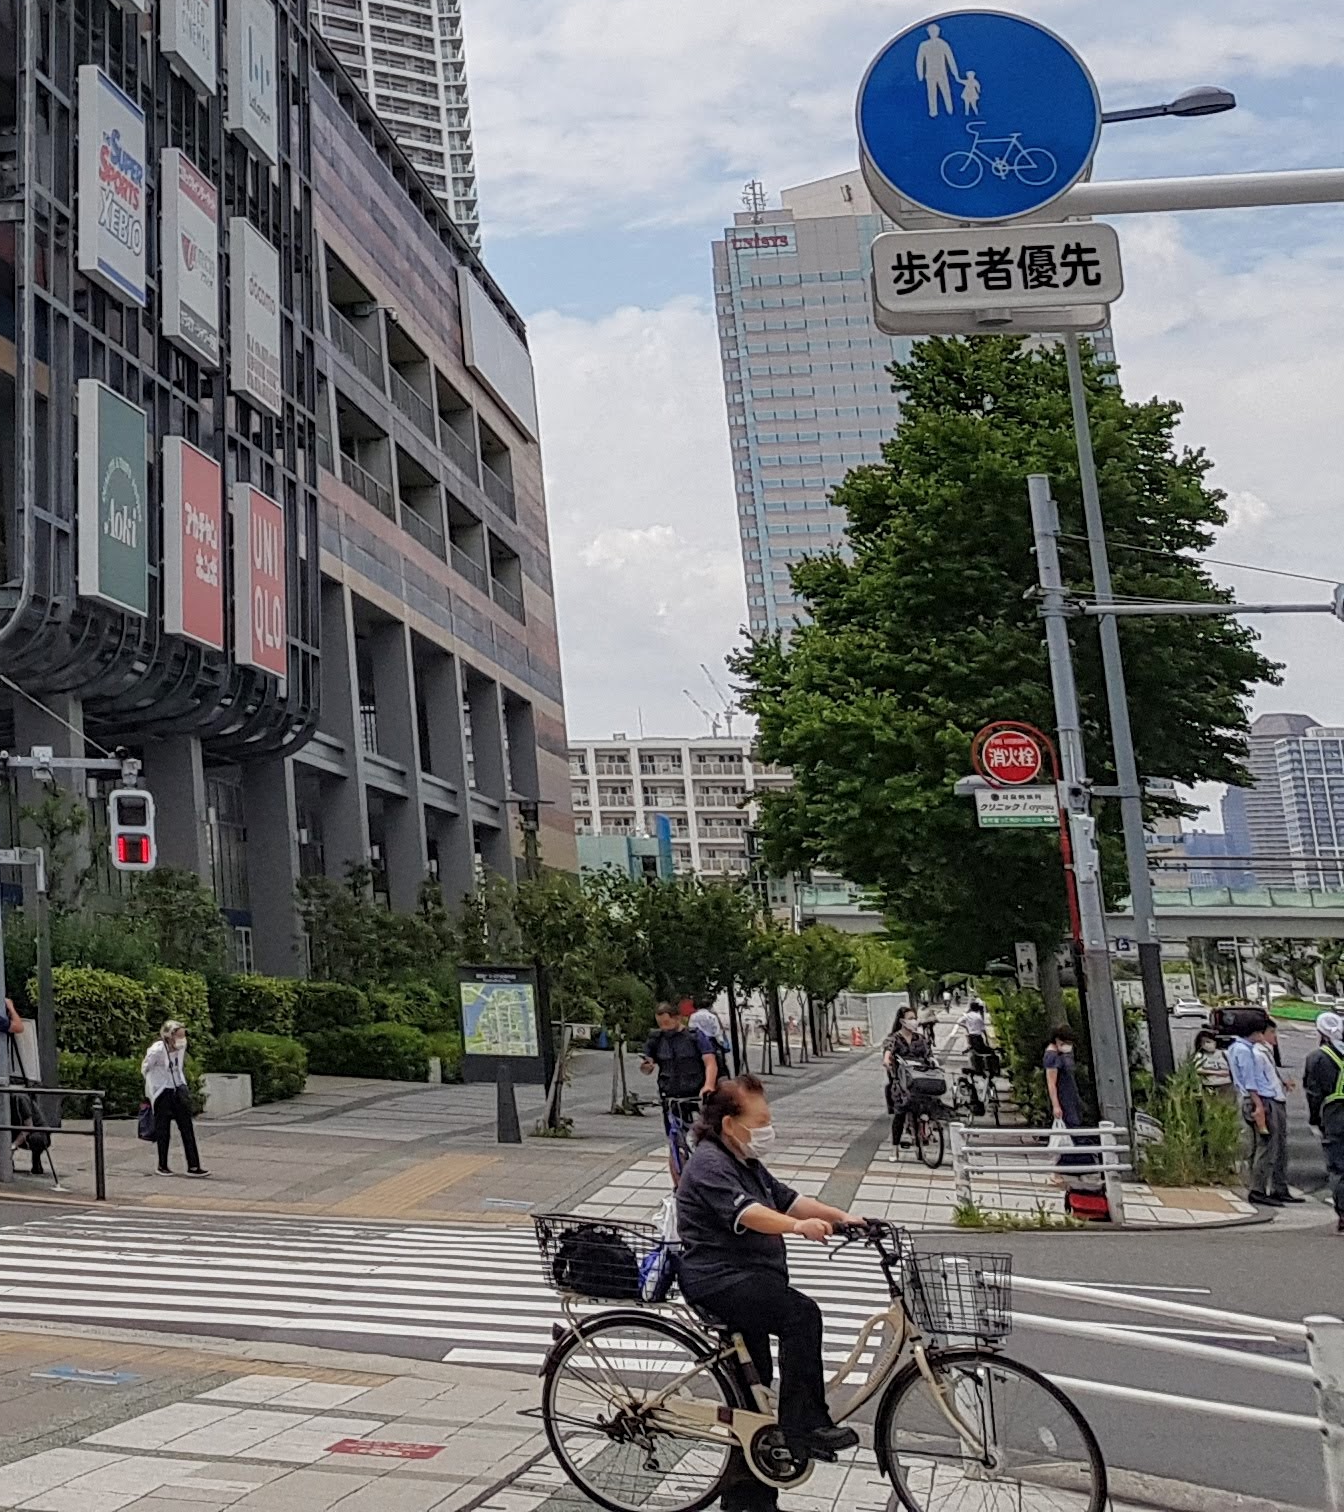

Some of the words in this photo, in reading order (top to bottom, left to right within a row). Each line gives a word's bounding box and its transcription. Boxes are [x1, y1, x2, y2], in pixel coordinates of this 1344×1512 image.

[98, 182, 143, 257] XEBIO
[891, 241, 1102, 296] 歩行者優先
[104, 498, 136, 548] Aoki
[252, 512, 279, 581] UNI
[254, 584, 282, 654] QLO
[988, 747, 1036, 767] 消火栓
